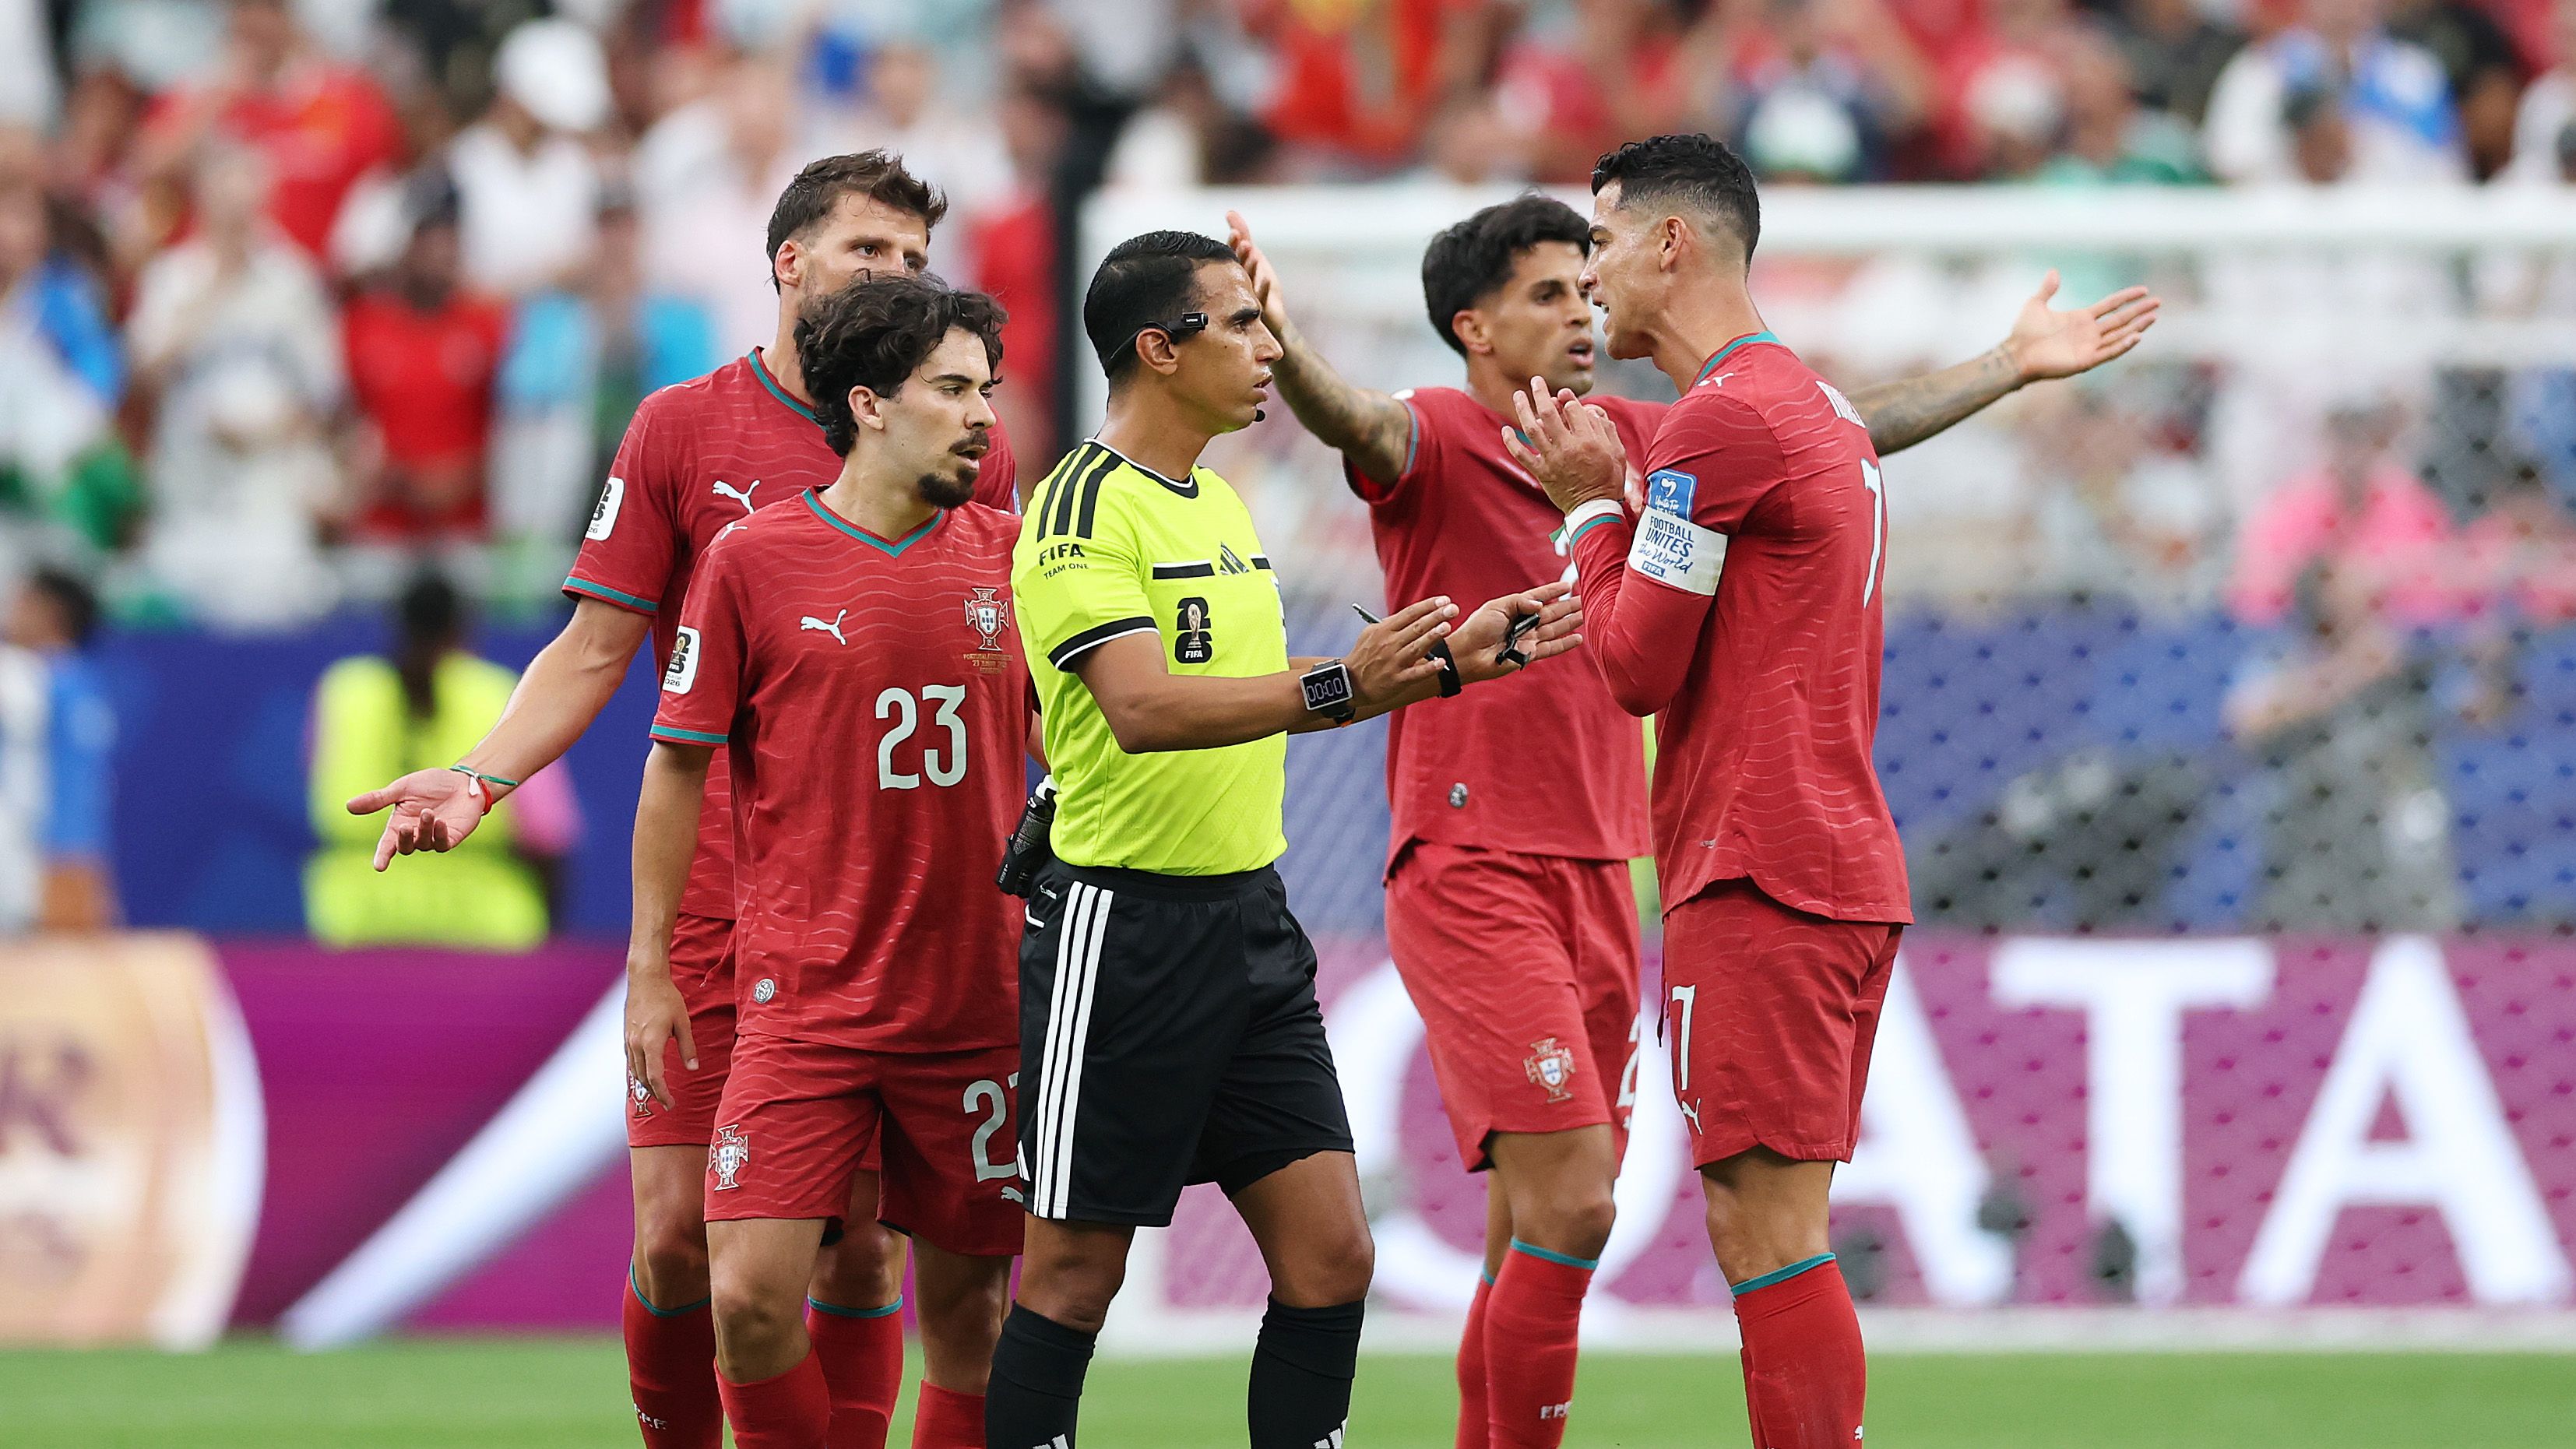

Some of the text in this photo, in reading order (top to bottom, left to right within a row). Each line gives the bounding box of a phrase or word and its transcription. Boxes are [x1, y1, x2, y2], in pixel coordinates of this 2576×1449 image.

[1649, 516, 1694, 543] FOOTBALL
[1039, 543, 1086, 567] FIFA
[1645, 528, 1694, 557] UNITES
[1043, 564, 1066, 580] TEAM
[1642, 561, 1665, 578] FIFA
[1652, 549, 1694, 575] World
[1185, 649, 1203, 659] FIFA
[665, 678, 681, 687] 026
[1306, 677, 1343, 702] 00:00
[875, 685, 967, 791] 23
[1672, 984, 1696, 1091] 7
[963, 1071, 1019, 1183] 2
